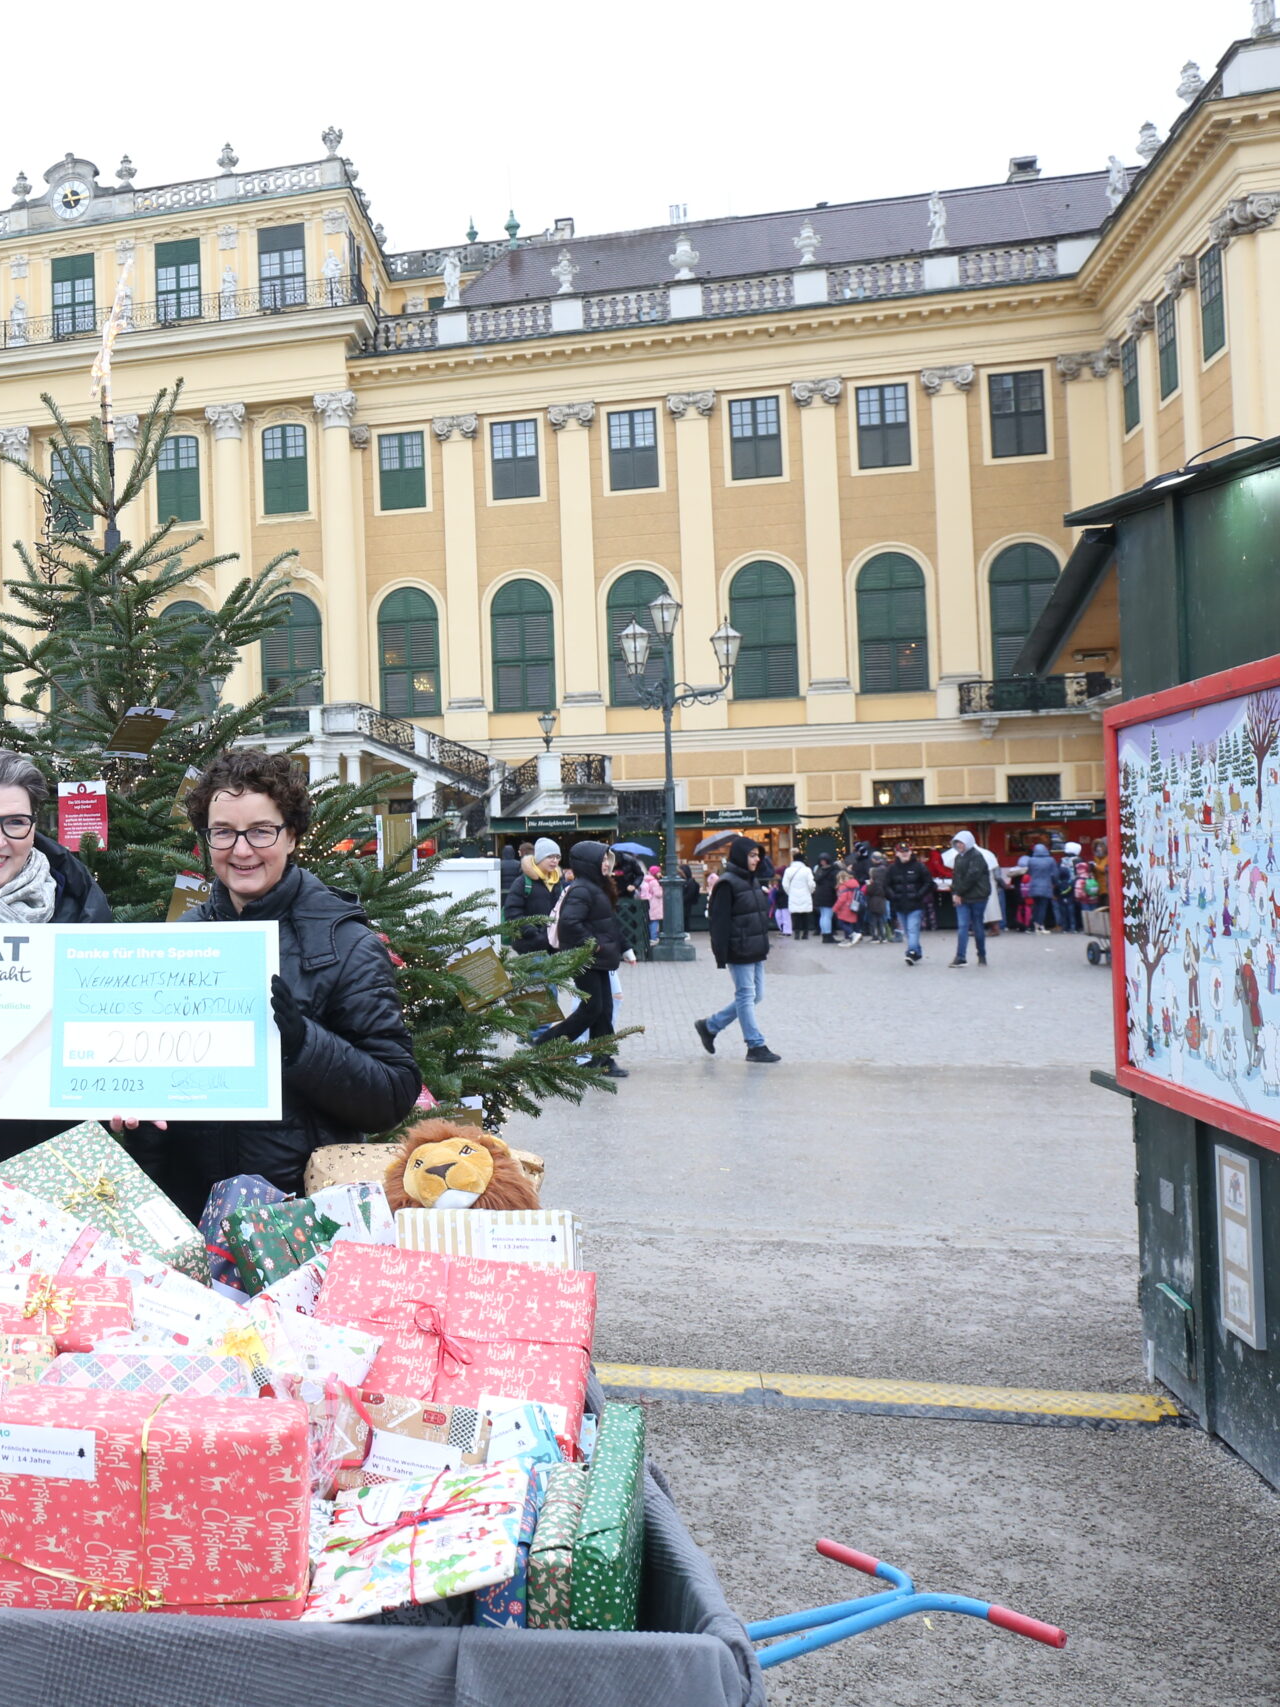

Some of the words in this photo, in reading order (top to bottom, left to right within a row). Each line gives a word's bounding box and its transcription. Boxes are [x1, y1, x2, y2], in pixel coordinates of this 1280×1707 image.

[67, 948, 110, 959] Danke
[112, 948, 134, 959] für
[136, 948, 165, 959] Ihre
[167, 947, 221, 960] Spende
[69, 1050, 94, 1060] EUR
[380, 1258, 408, 1275] Merry
[467, 1268, 495, 1286] Merry
[557, 1278, 586, 1295] Merry
[376, 1279, 425, 1298] Christmas
[465, 1291, 514, 1311] Christmas
[480, 1306, 507, 1325] Merry
[395, 1333, 424, 1350] Merry
[487, 1342, 516, 1361] Merry
[484, 1367, 536, 1387] Christmas
[1, 1444, 30, 1453] Fröhliche
[105, 1433, 134, 1469] Merry
[30, 1456, 51, 1465] Jahre
[393, 1466, 414, 1476] Jahre
[201, 1507, 231, 1572] Christmas
[226, 1515, 256, 1551] Merry
[265, 1508, 295, 1574] Christmas
[165, 1535, 195, 1570] Merry
[108, 1549, 138, 1584] Merry
